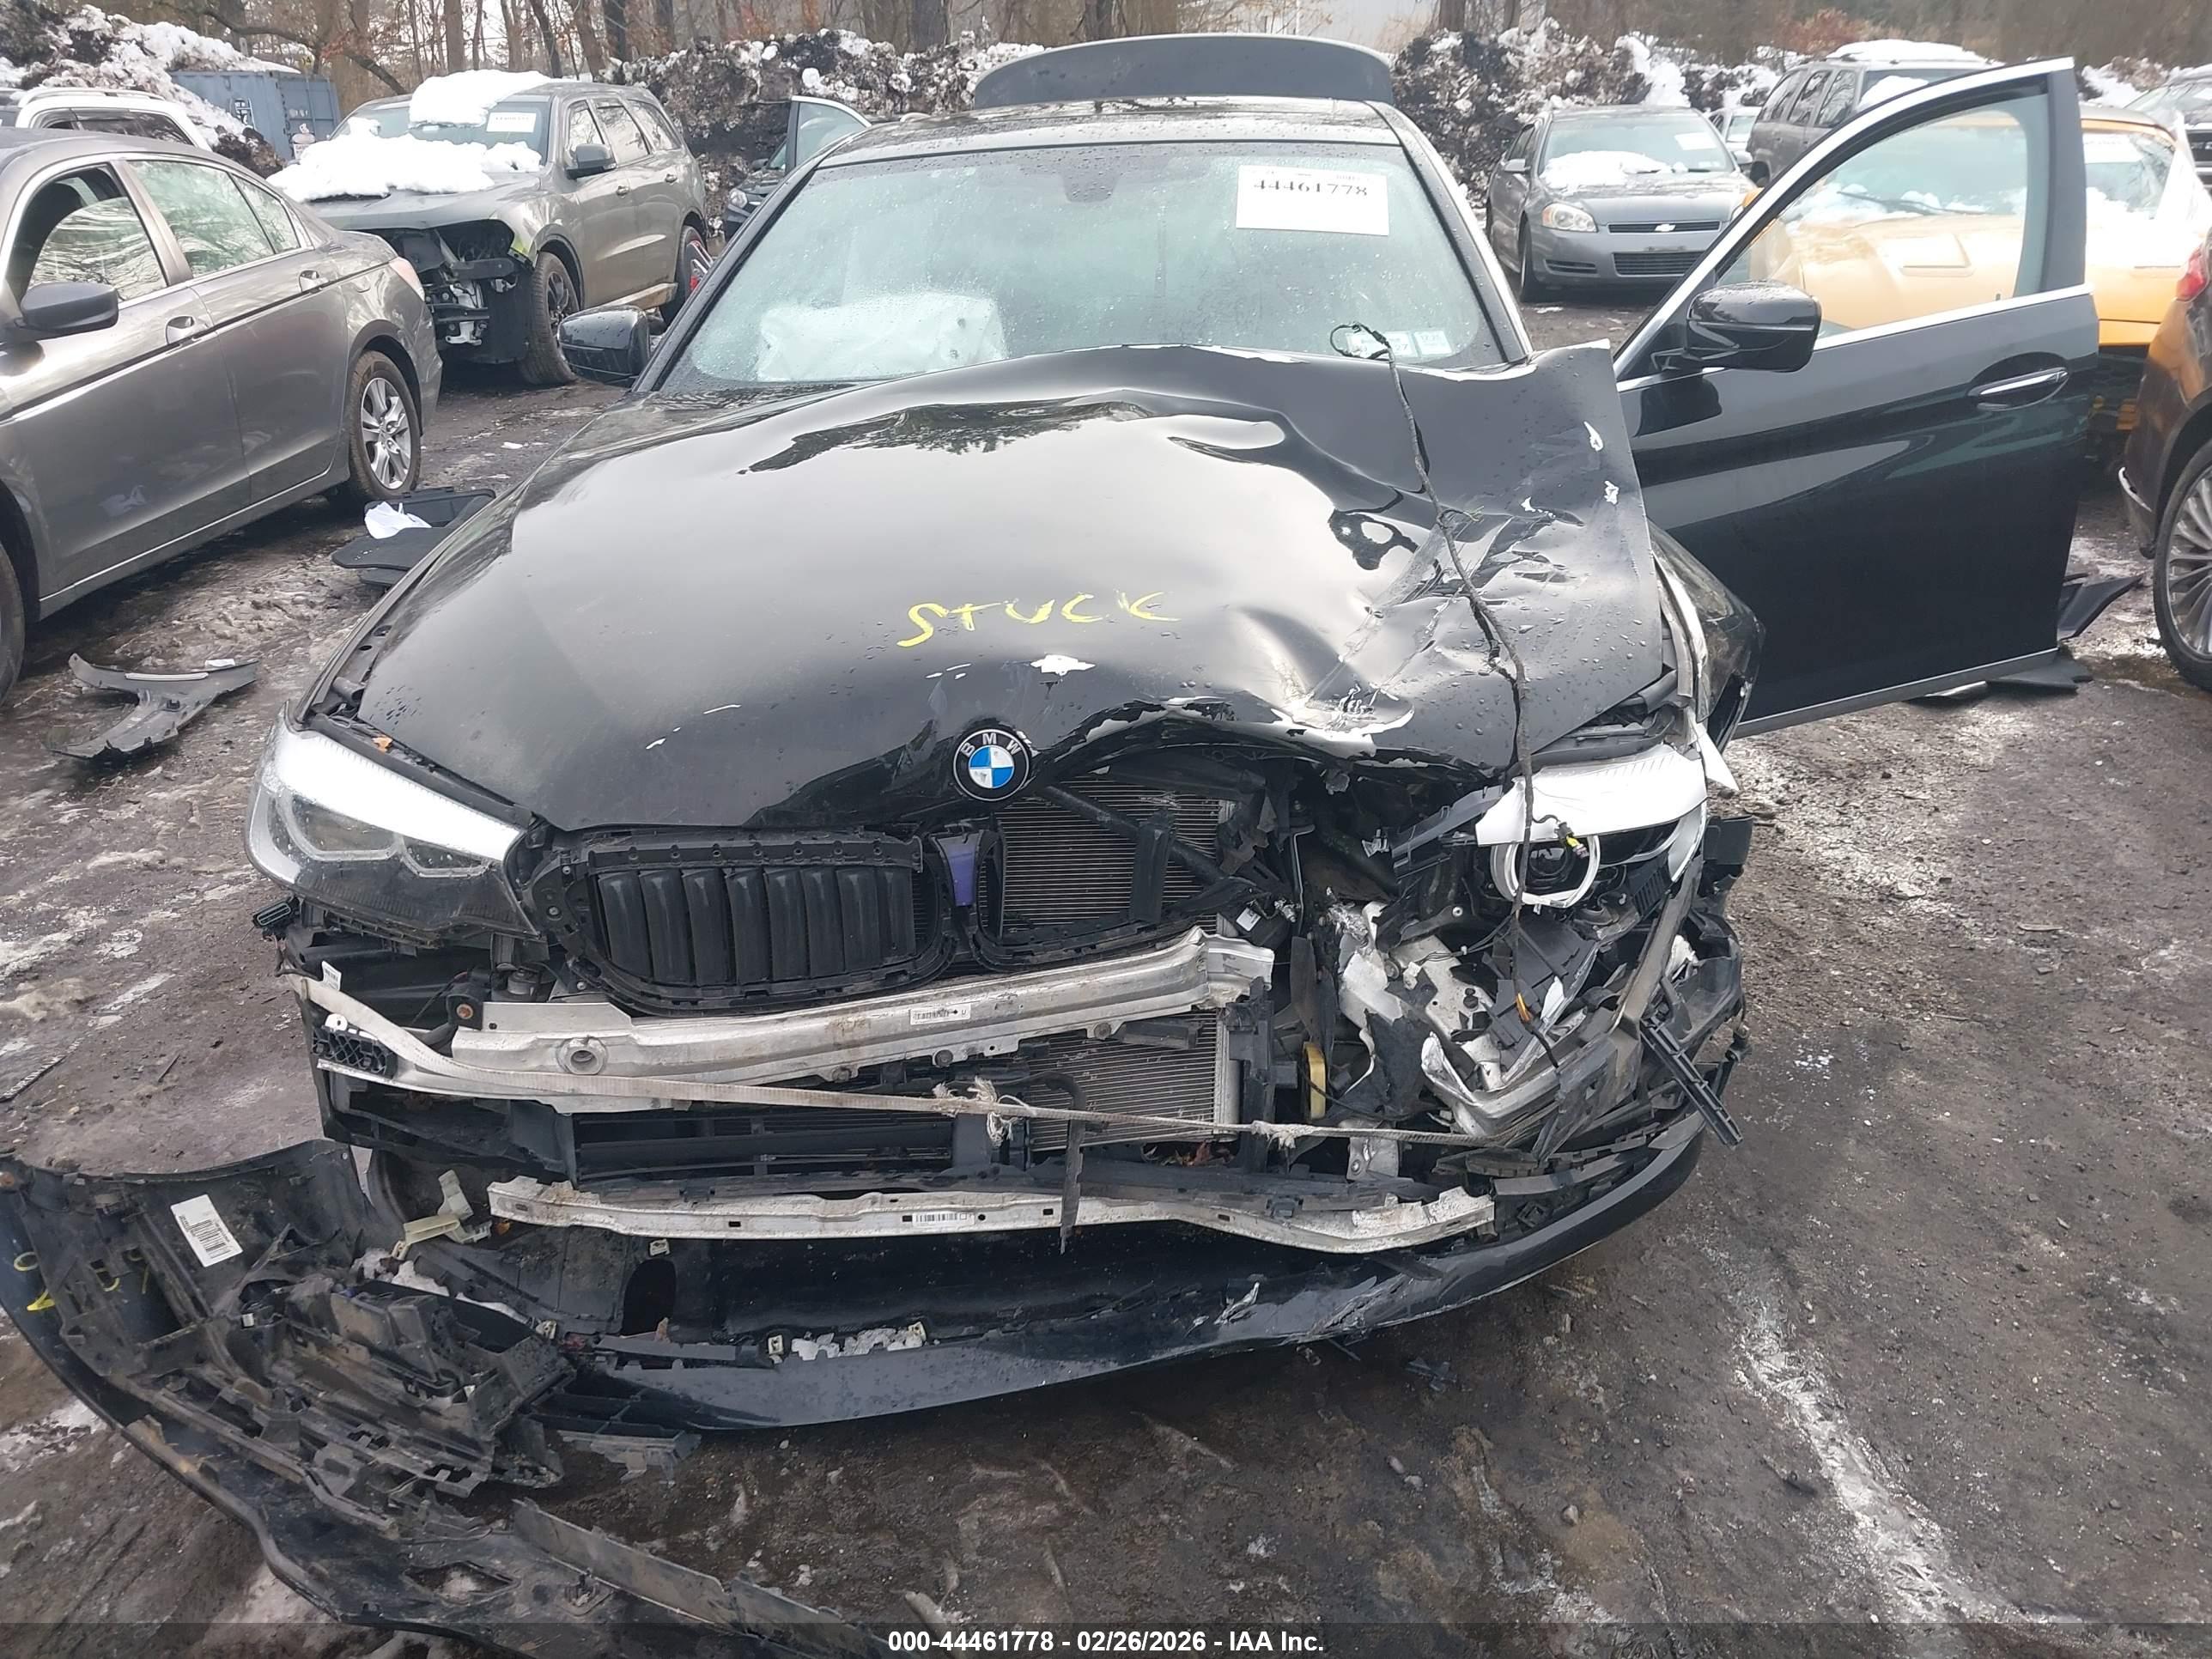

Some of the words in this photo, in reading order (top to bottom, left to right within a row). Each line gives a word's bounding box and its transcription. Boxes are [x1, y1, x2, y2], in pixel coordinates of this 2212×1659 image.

[1254, 179, 1368, 196] 44461778
[896, 591, 1182, 648] STUCK
[959, 732, 1022, 758] BMW
